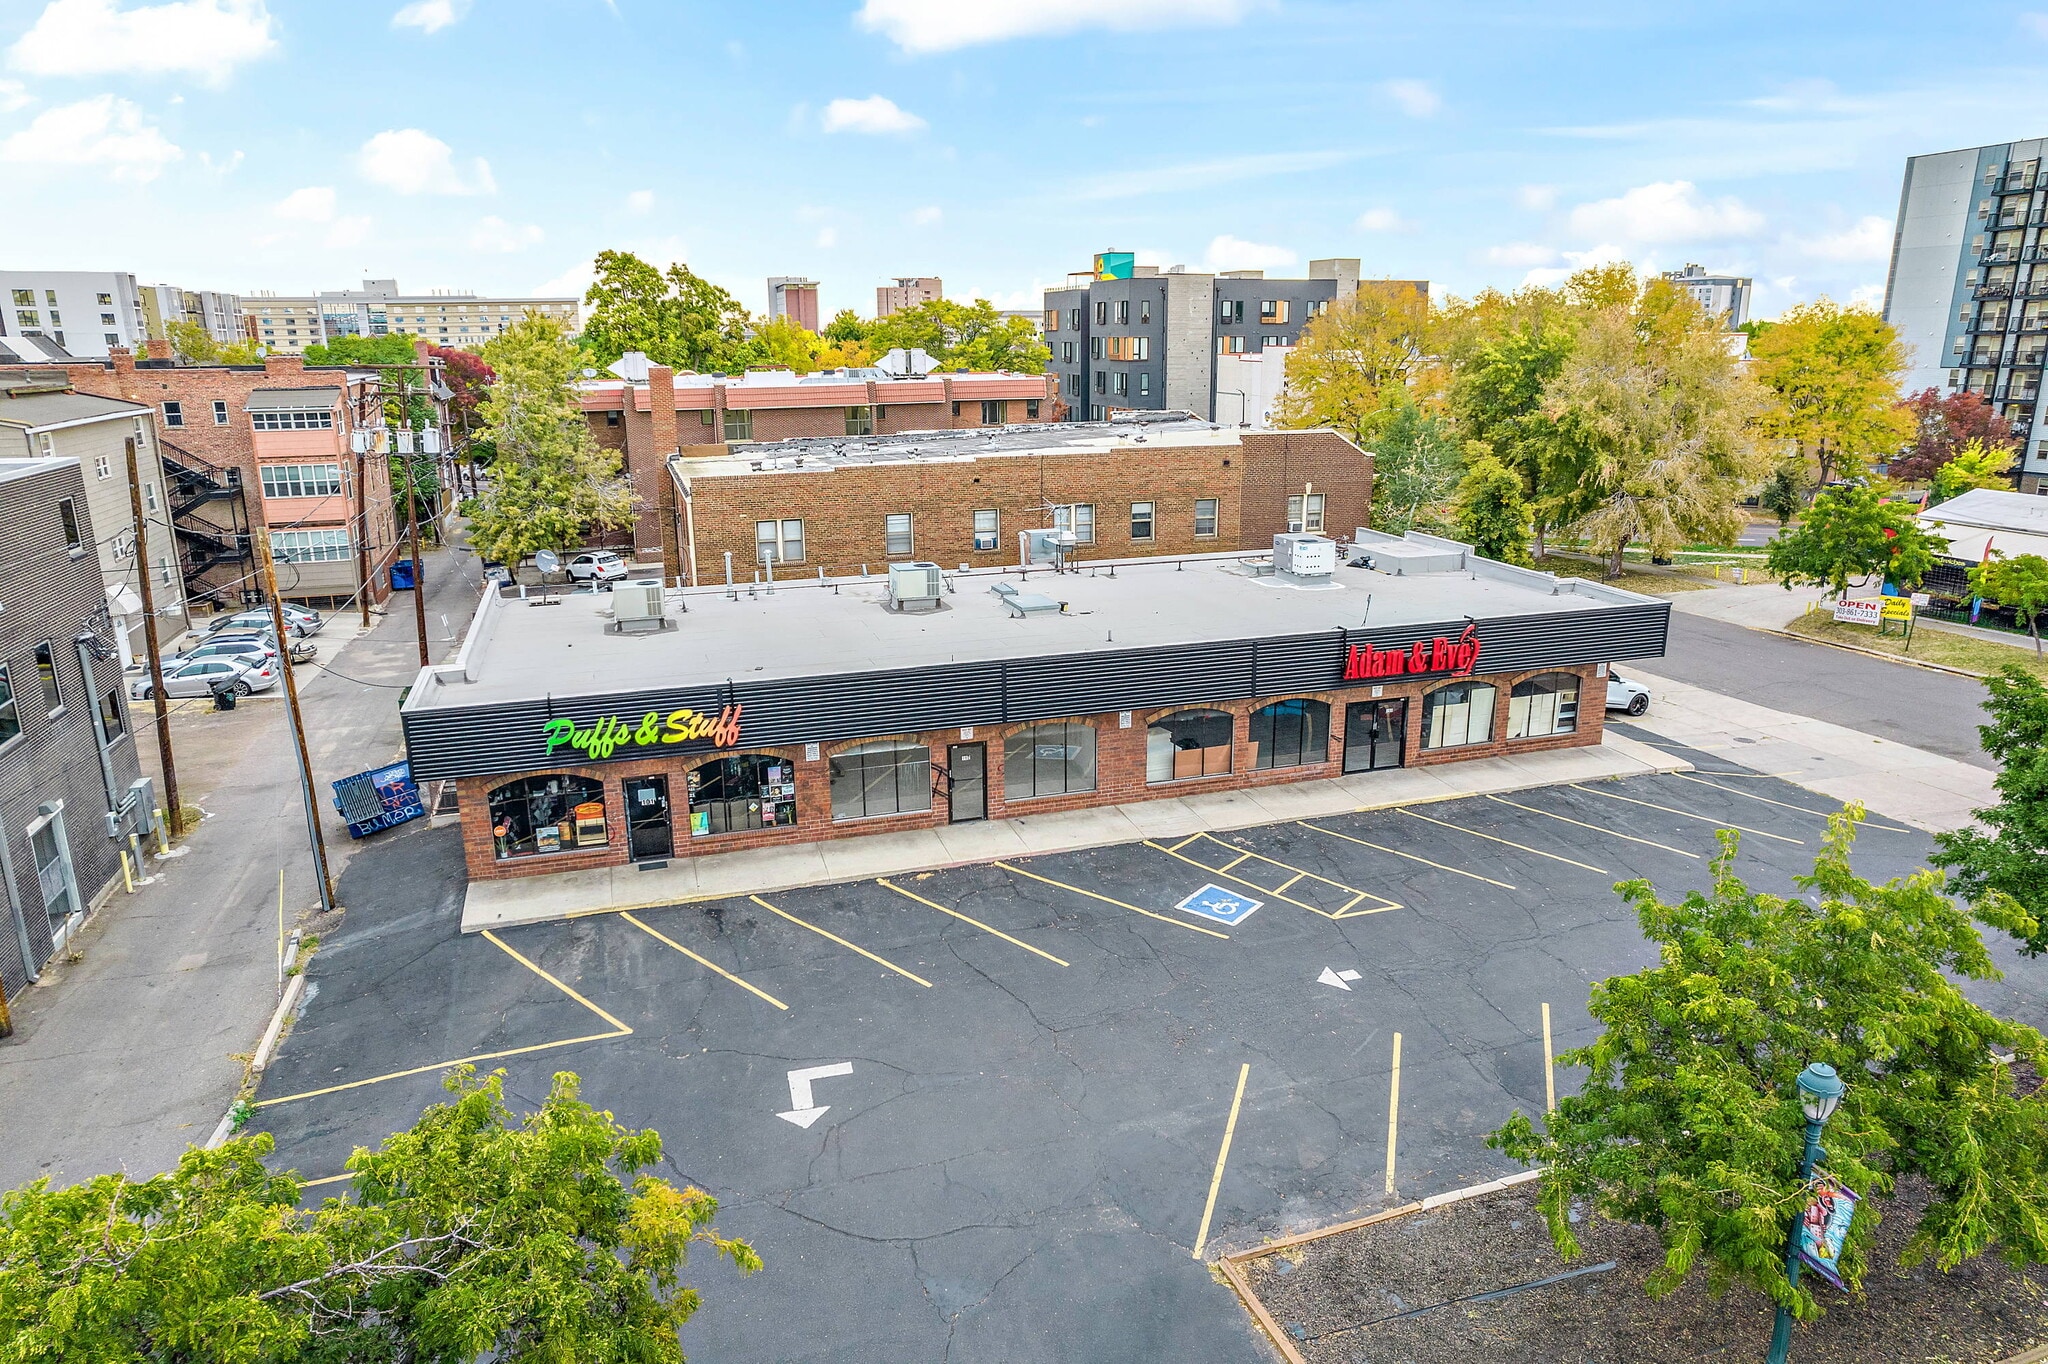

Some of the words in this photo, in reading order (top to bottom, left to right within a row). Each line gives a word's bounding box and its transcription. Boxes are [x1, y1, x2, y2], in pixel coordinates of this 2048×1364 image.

[1838, 600, 1877, 611] OPEN
[1884, 598, 1906, 607] Daily
[1836, 606, 1878, 619] 303-861-7333
[1880, 606, 1910, 617] Specials
[1343, 643, 1404, 680] Adam
[1408, 641, 1428, 674] &
[1431, 635, 1475, 672] Eve
[543, 715, 632, 760] Puffs
[635, 712, 659, 745] &
[662, 704, 743, 748] Stuff
